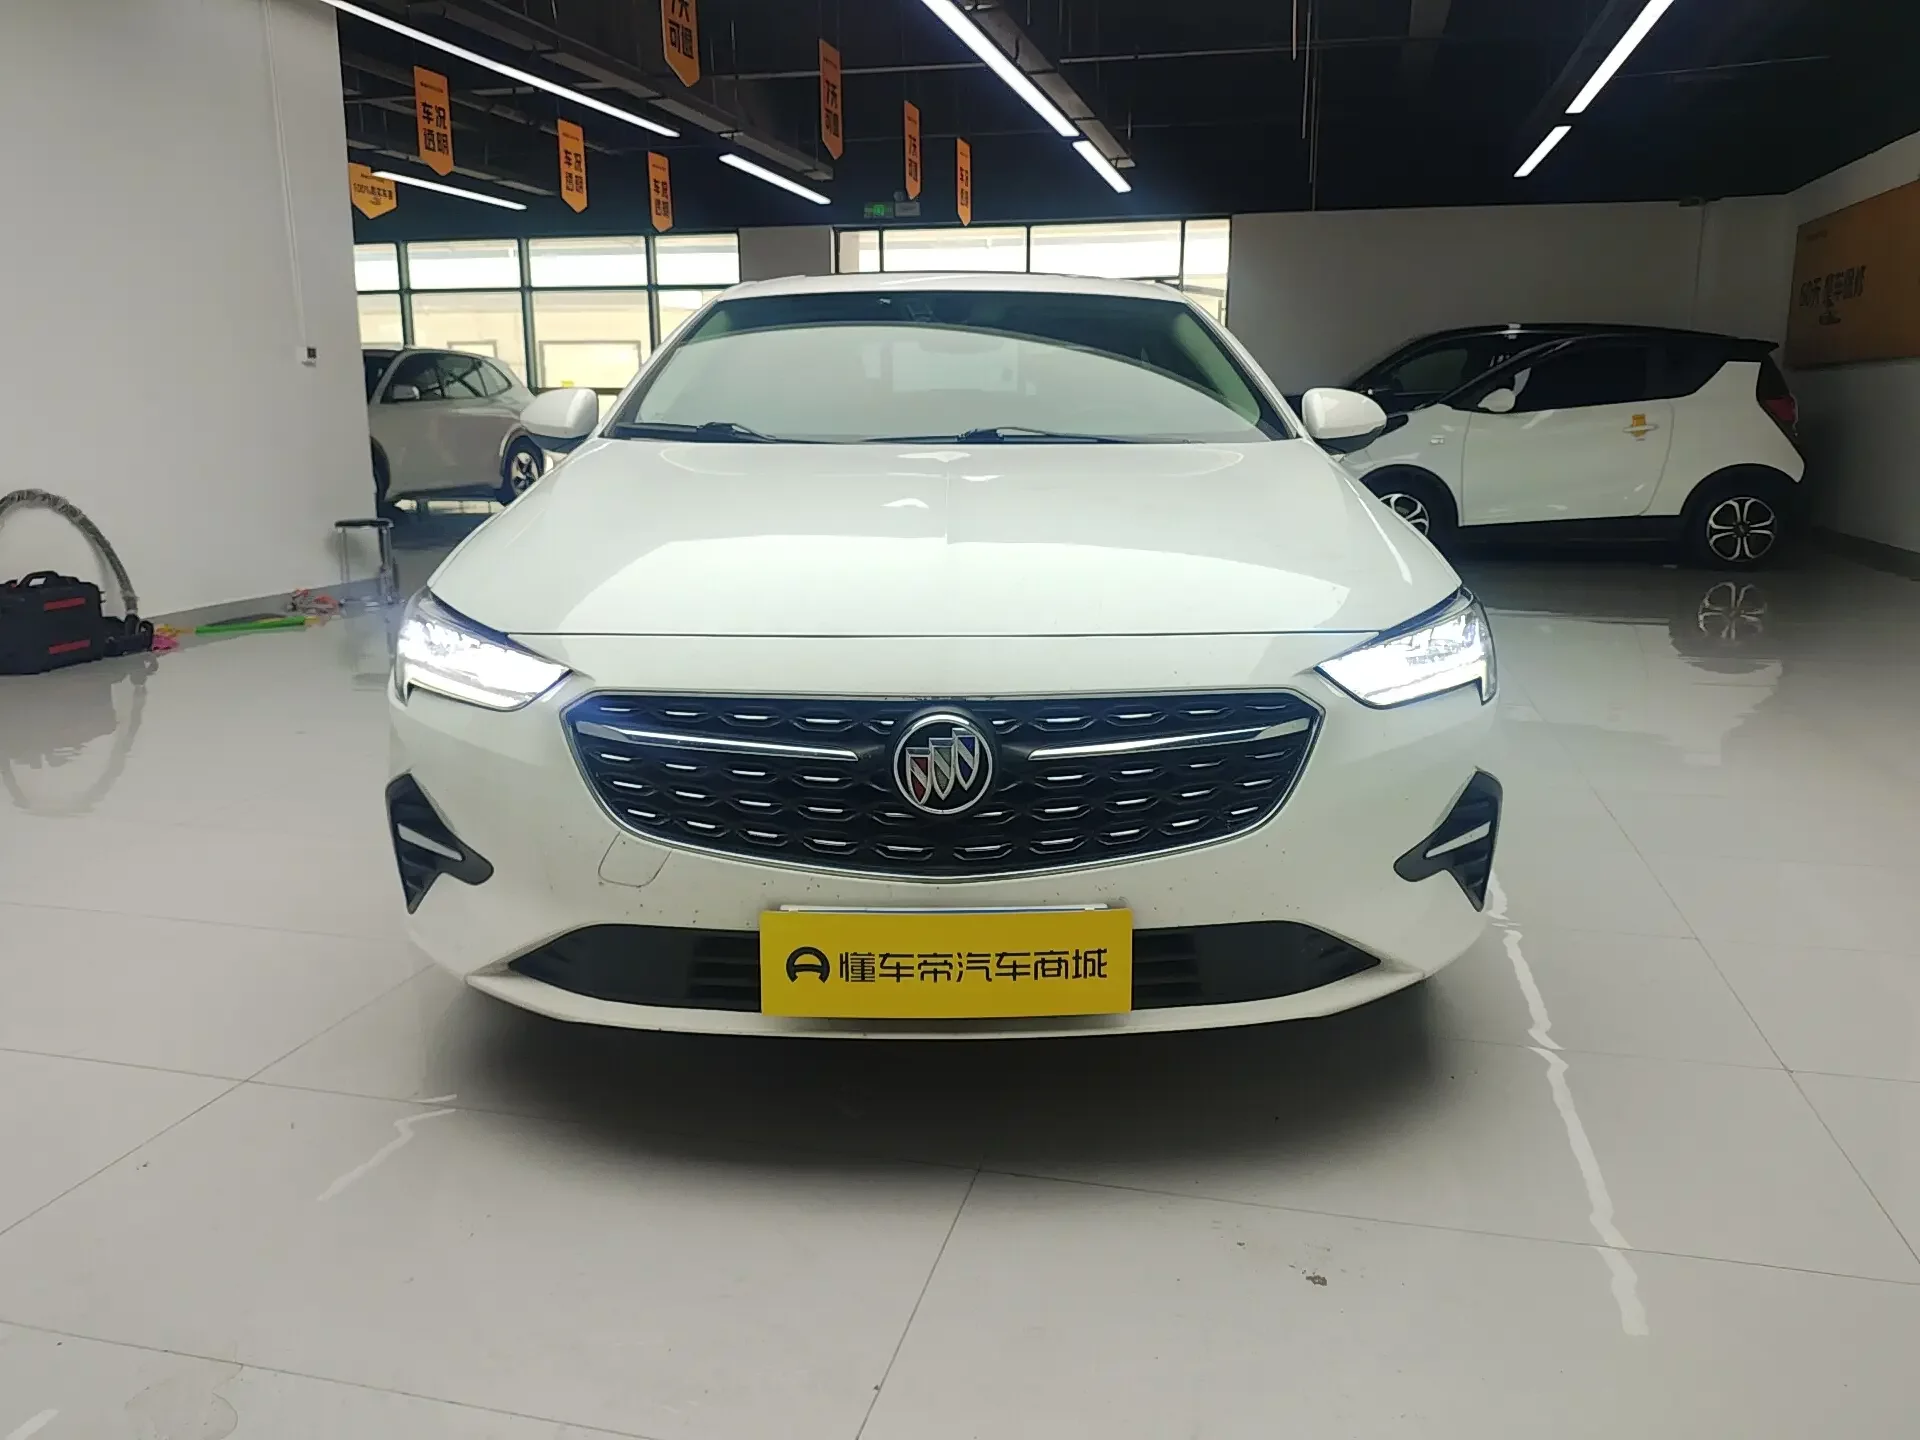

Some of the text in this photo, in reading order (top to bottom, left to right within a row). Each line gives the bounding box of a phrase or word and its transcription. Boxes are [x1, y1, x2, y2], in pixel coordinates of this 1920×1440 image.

[420, 100, 448, 129] 车况
[423, 128, 449, 156] 透明
[838, 947, 1108, 984] 懂车帝汽车商城
